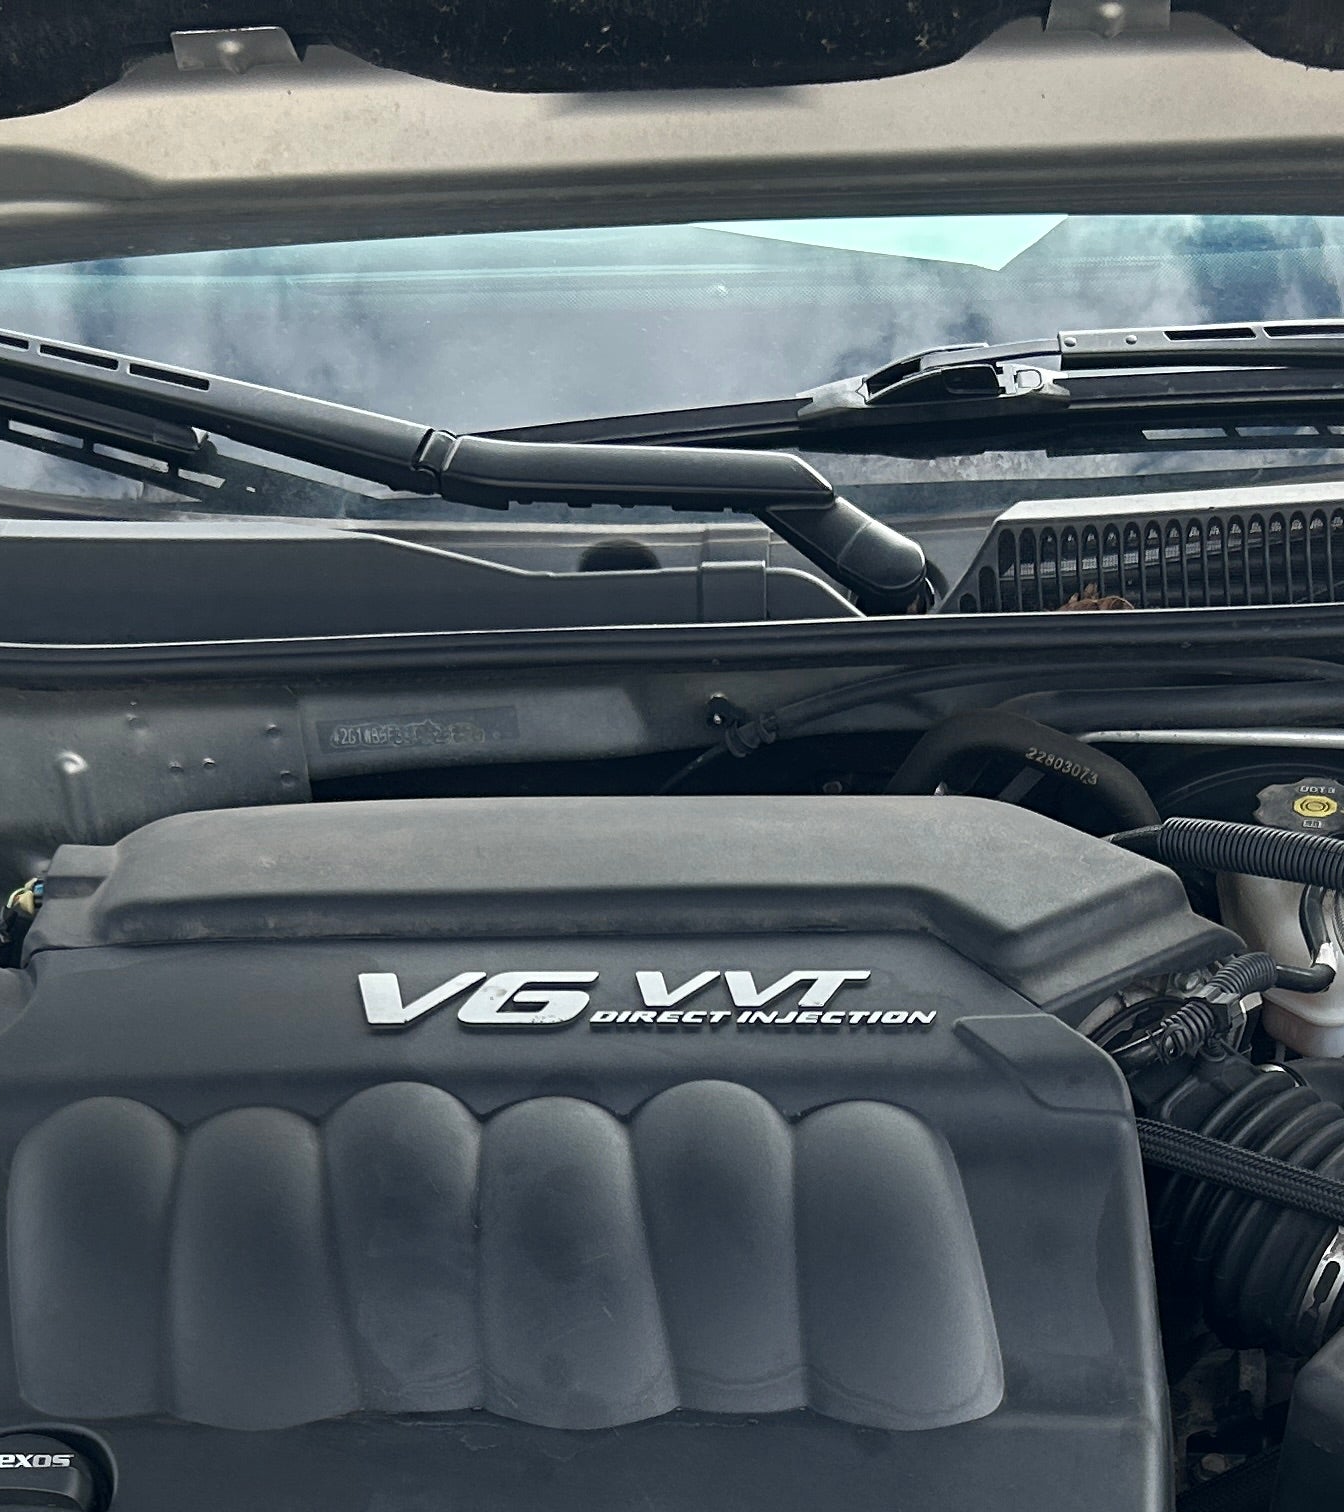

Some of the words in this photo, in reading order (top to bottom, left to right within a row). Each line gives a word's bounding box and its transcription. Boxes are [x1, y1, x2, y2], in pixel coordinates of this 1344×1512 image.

[1025, 747, 1099, 785] 22803073
[358, 971, 600, 1024] V6
[635, 970, 872, 1007] VVT
[590, 1011, 732, 1024] DIRECT
[736, 1011, 937, 1024] INJECTION
